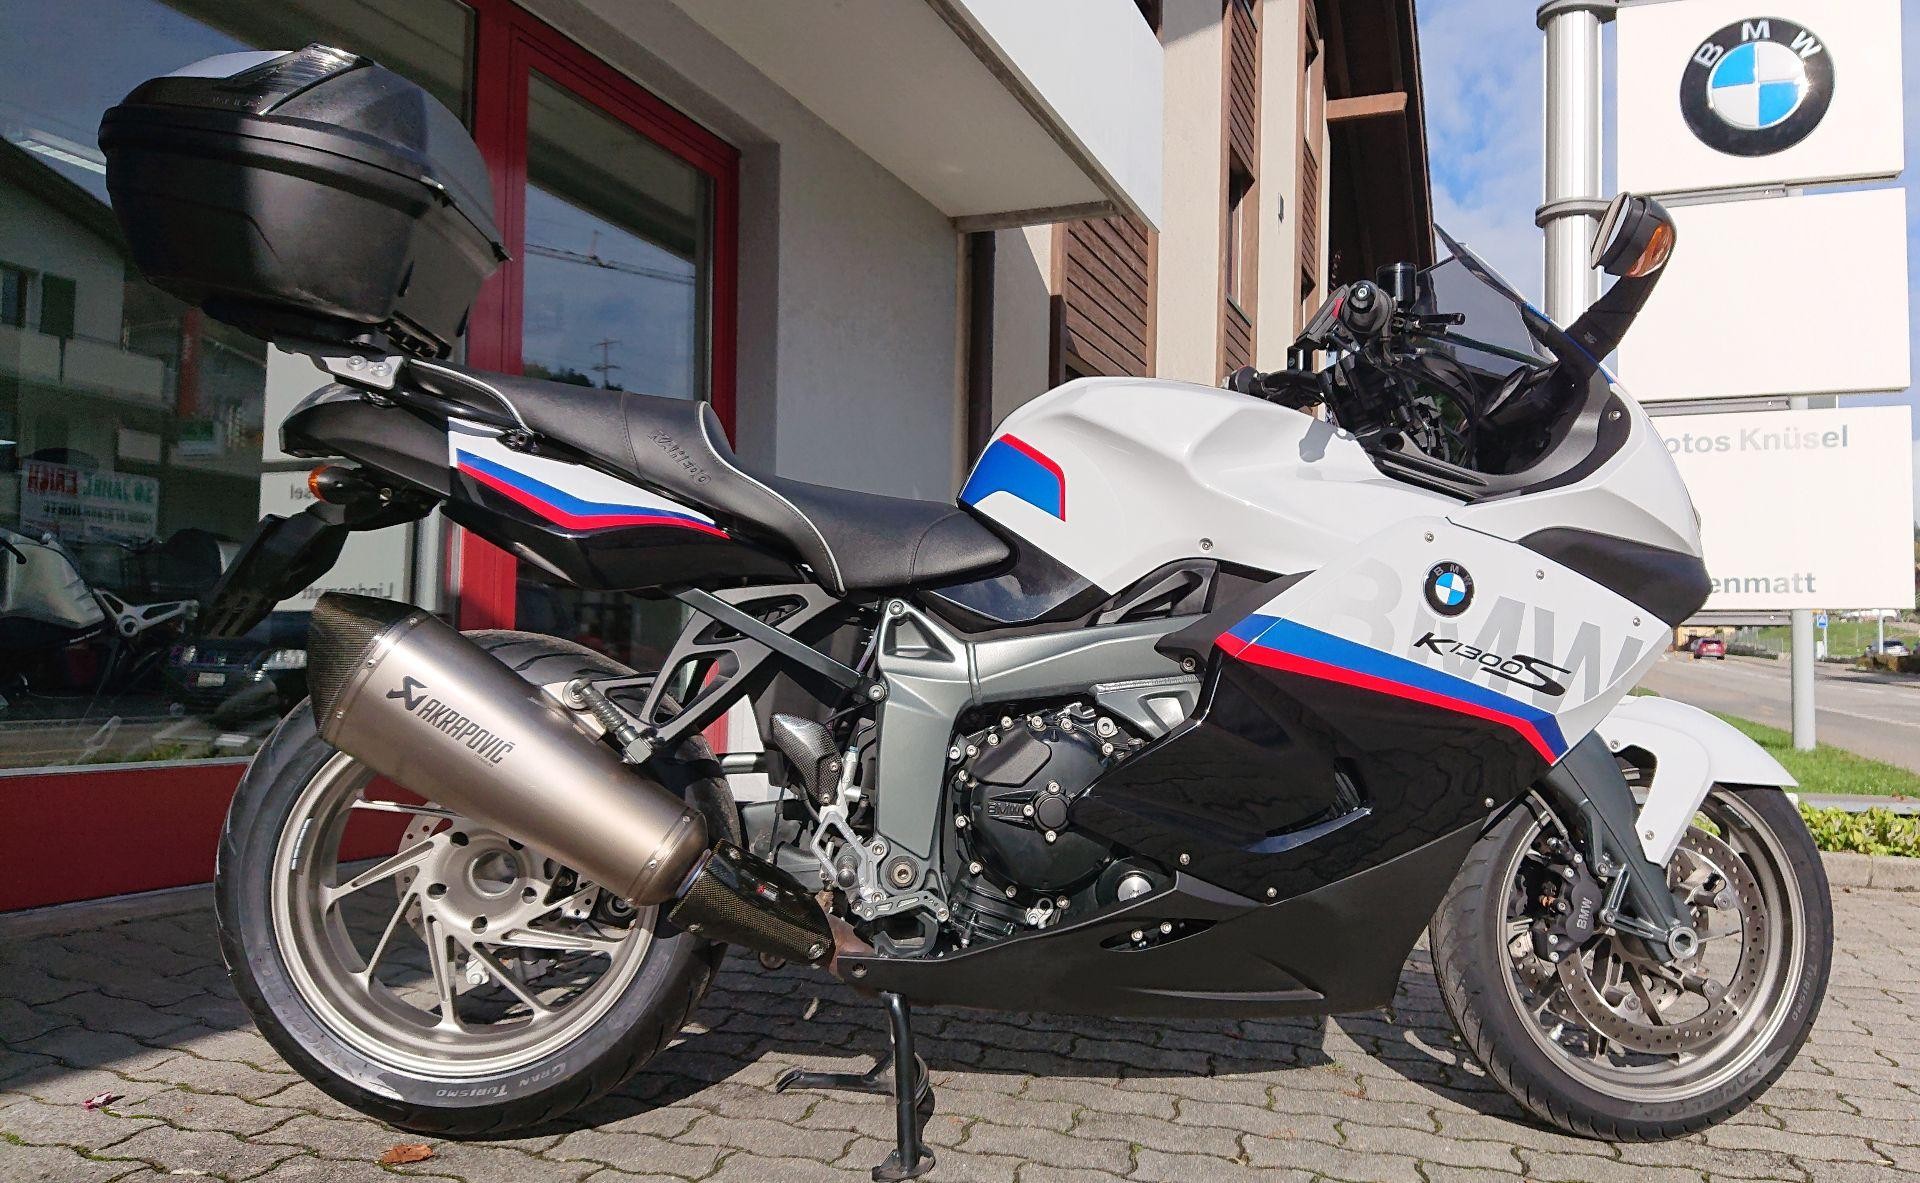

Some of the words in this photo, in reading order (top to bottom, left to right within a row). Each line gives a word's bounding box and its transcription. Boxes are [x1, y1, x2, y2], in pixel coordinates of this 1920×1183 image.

[1694, 19, 1822, 67] BMW
[1740, 424, 1848, 451] Knüsel
[1433, 563, 1473, 588] BMW
[1310, 558, 1644, 714] BMW
[988, 801, 1021, 816] BMW
[1577, 897, 1593, 930] BMW
